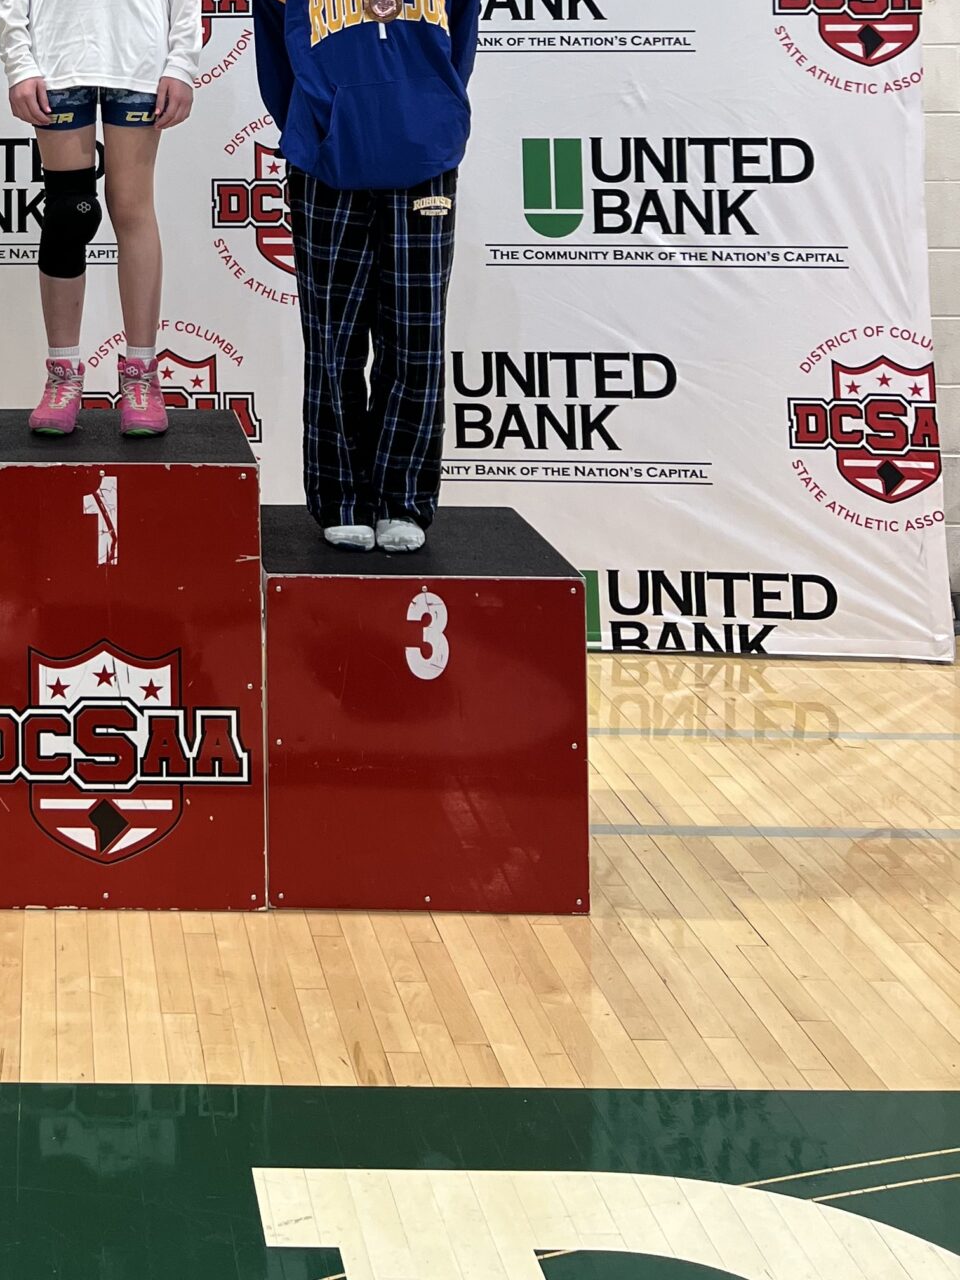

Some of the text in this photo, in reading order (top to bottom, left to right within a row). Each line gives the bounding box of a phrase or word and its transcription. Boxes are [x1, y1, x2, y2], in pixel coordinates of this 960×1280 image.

[590, 137, 814, 184] UNITED
[592, 189, 759, 235] BANK
[490, 250, 844, 262] THE COMMUNITY BANK OF THE NATION'S CAPITAL
[800, 326, 884, 374] DISTRICT OF
[451, 351, 676, 399] UNITED
[453, 403, 621, 450] BANK
[787, 392, 939, 454] DCSA
[82, 475, 119, 566] 1
[825, 500, 899, 532] ATHLETIC
[607, 570, 837, 620] UNITED
[406, 592, 449, 680] 3
[609, 621, 778, 653] BANK
